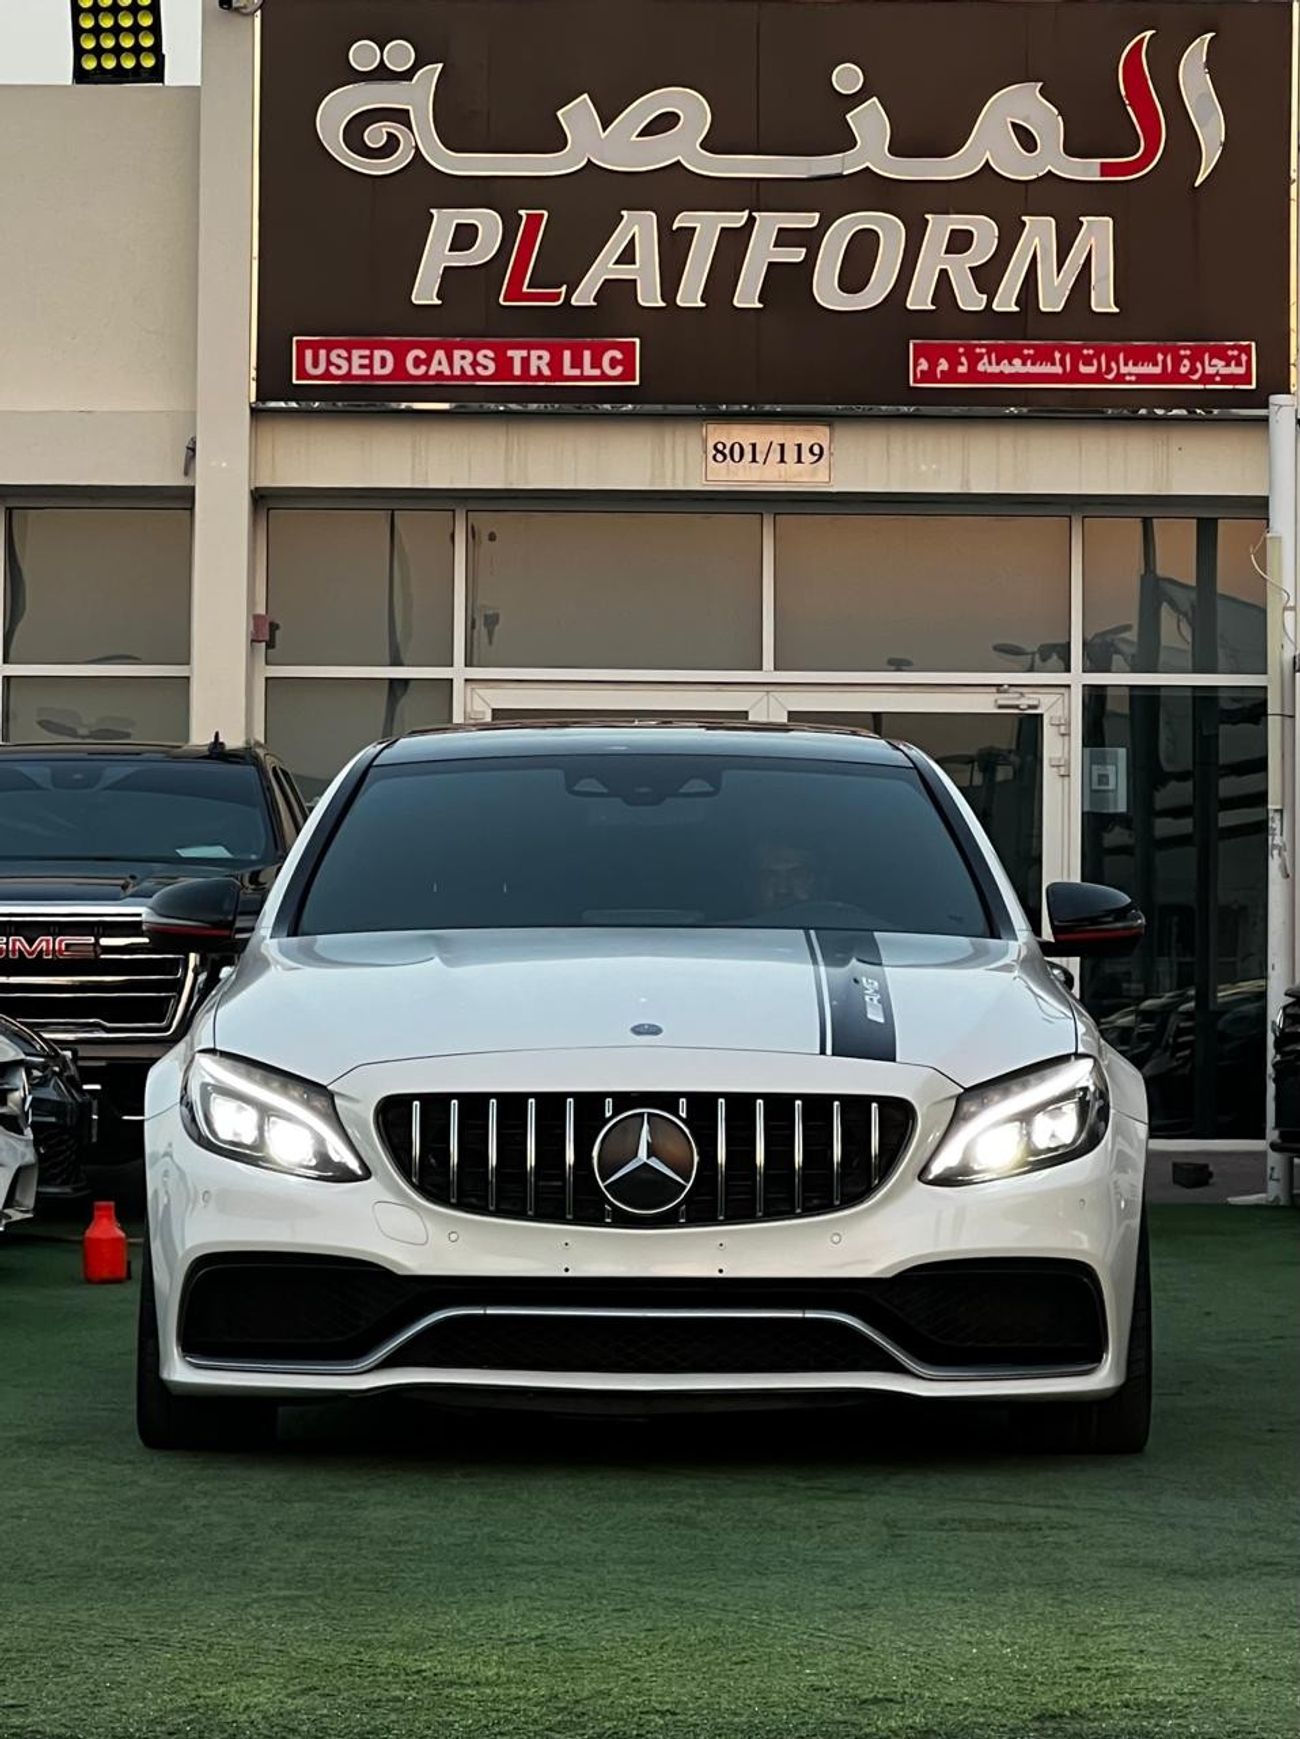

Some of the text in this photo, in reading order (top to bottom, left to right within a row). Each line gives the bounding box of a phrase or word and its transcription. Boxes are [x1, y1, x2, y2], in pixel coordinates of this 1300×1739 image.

[315, 29, 1225, 188] المنصة
[410, 208, 1120, 313] PLATFORM
[304, 349, 624, 376] USED CARS TR LLC
[915, 347, 1248, 381] لتجارة السيارات المستعملة ذ م م
[711, 440, 825, 466] 801/119
[0, 936, 95, 958] MC
